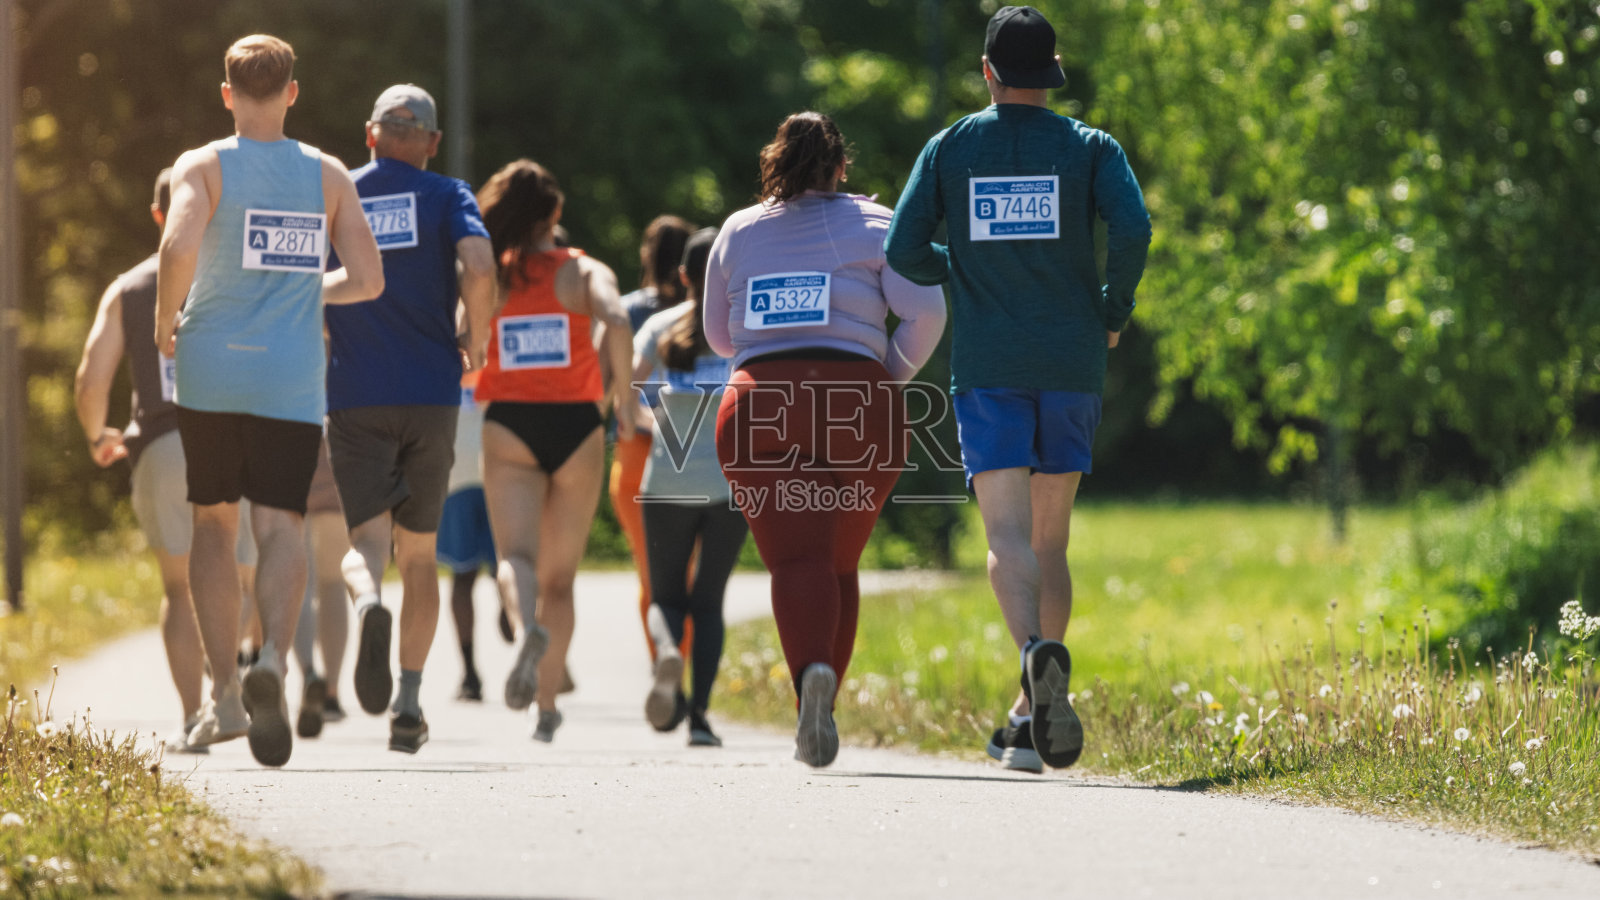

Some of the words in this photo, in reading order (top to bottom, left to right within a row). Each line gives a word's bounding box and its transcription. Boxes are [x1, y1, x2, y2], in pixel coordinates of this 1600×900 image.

[980, 202, 992, 216] B
[1000, 196, 1052, 219] 7446
[252, 232, 265, 247] A
[274, 230, 316, 253] 2871
[754, 296, 767, 310] A
[775, 288, 823, 310] 5327
